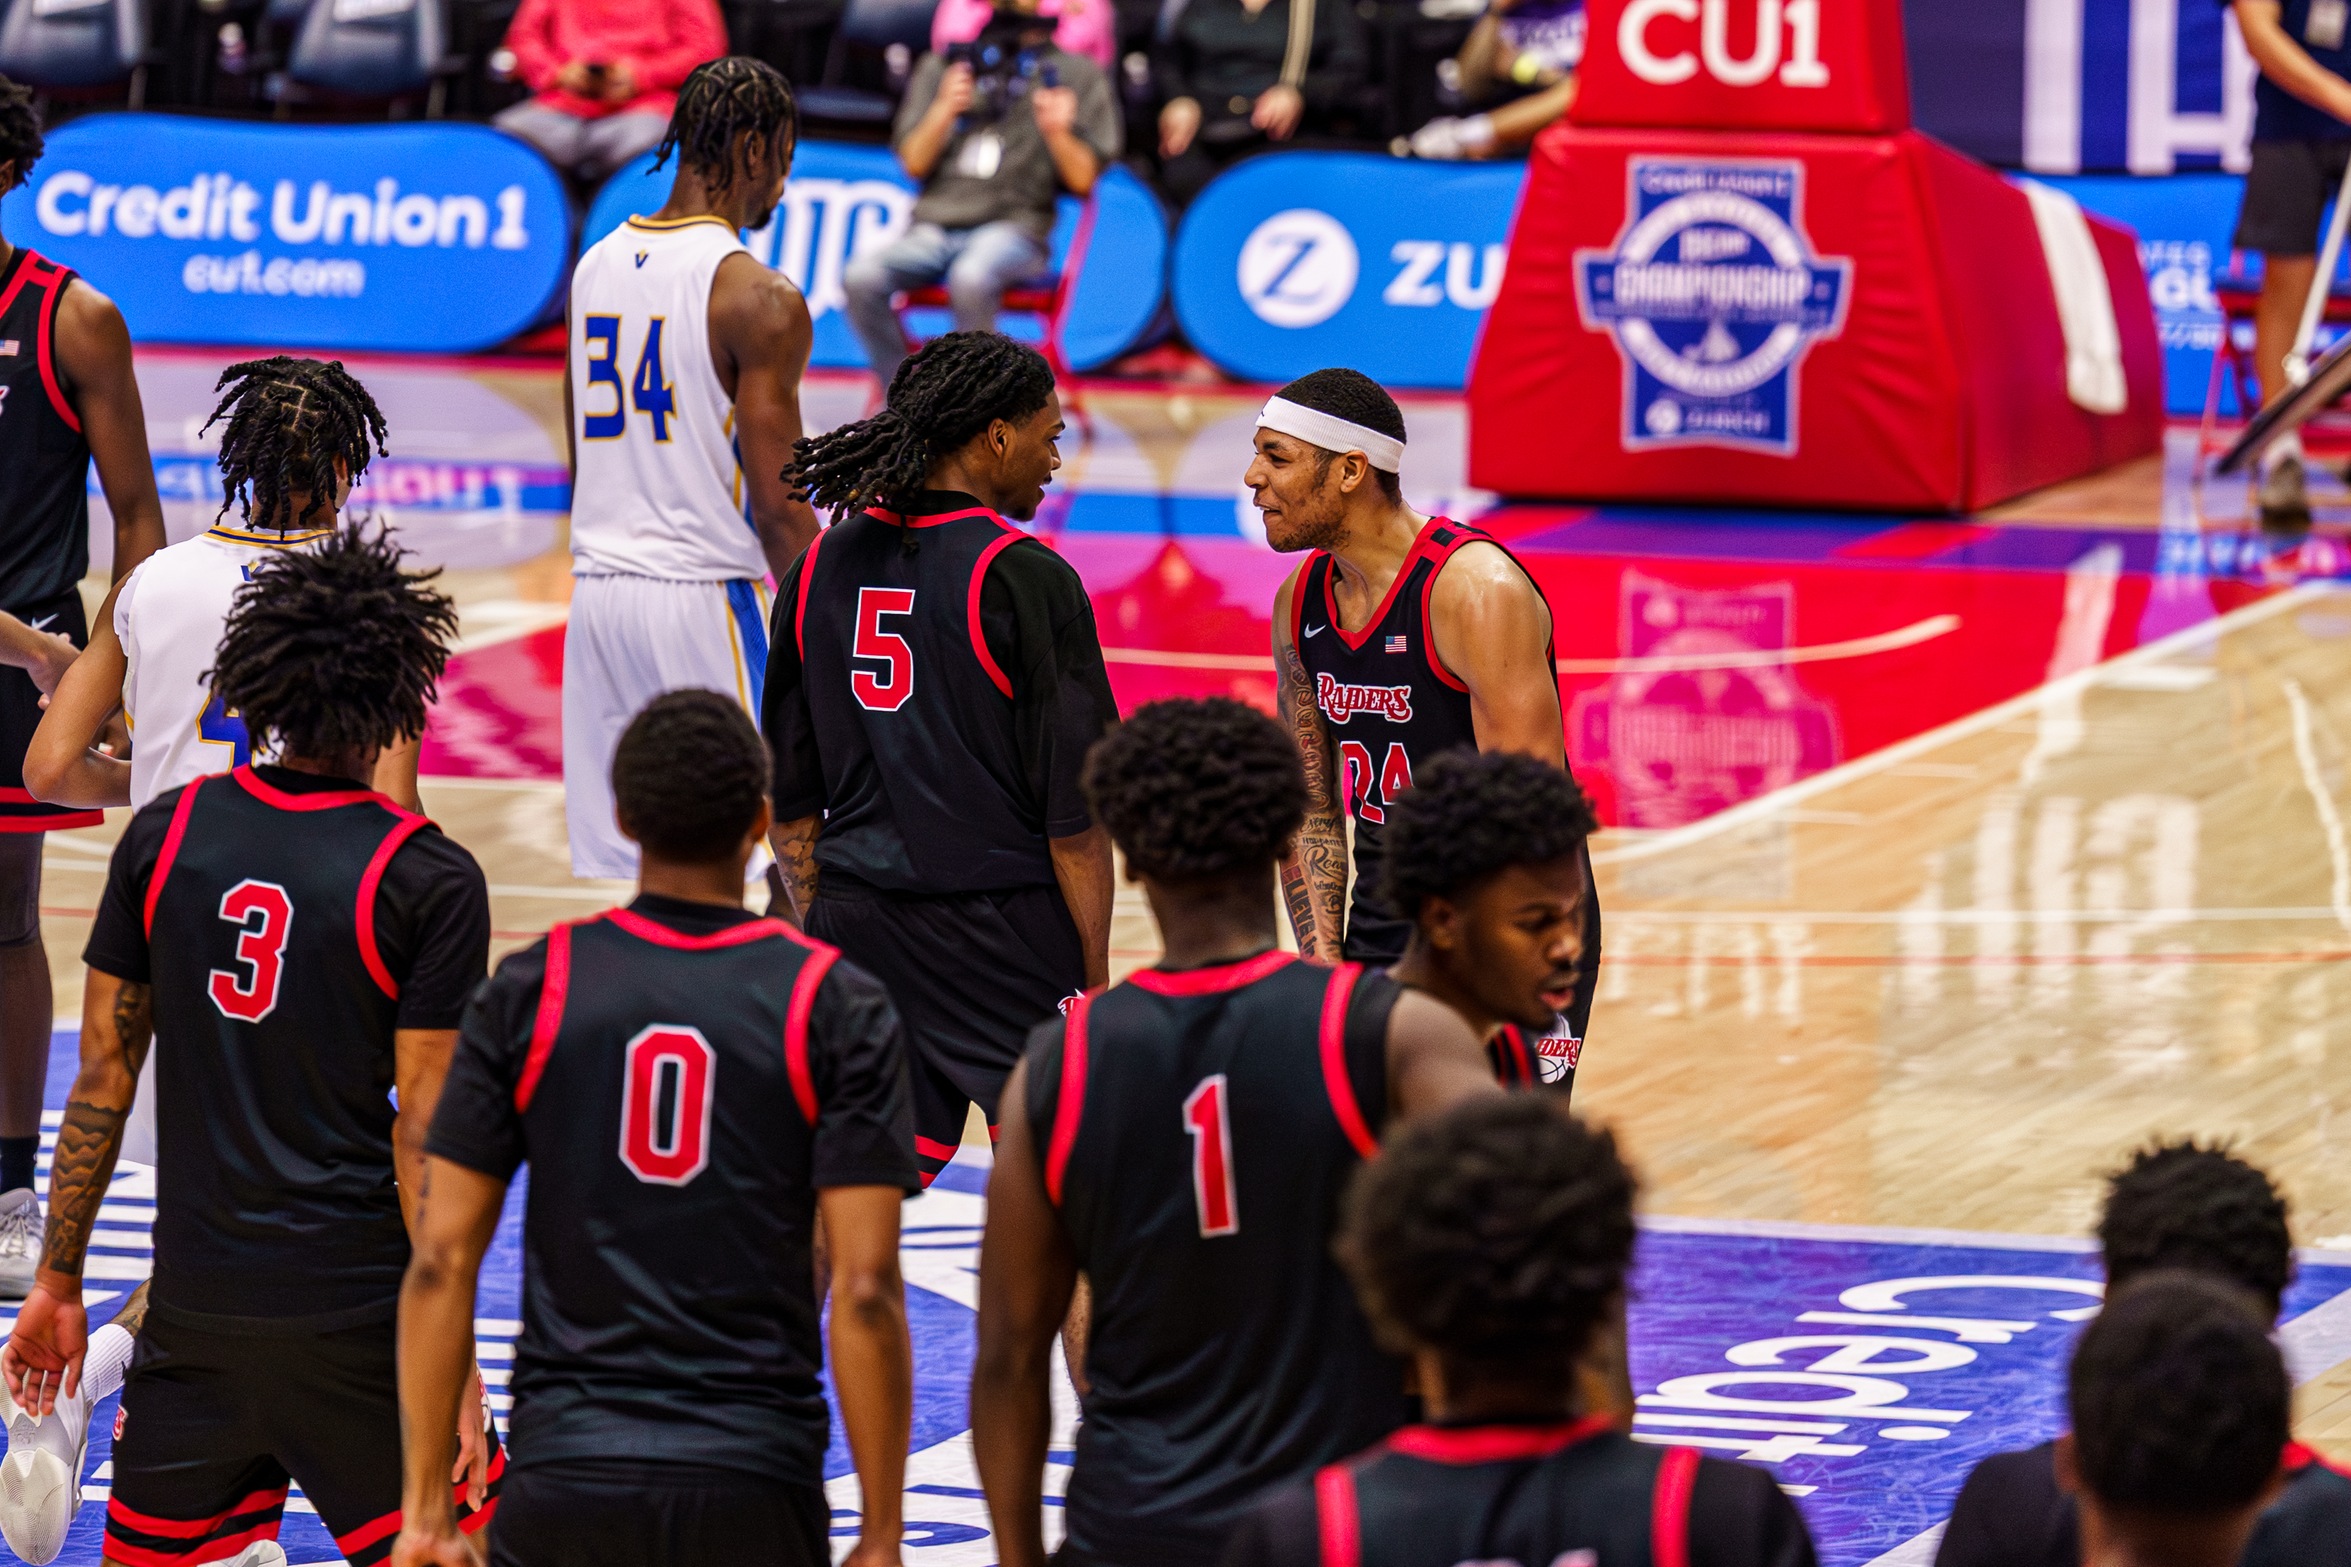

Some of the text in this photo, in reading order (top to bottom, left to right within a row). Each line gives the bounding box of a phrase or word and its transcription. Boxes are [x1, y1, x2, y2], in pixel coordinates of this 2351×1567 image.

[1617, 0, 1830, 88] CU1
[36, 168, 260, 243] Credit
[583, 312, 677, 444] 34
[851, 586, 916, 712] 5
[1317, 672, 1413, 725] RAIDERS
[1340, 740, 1414, 825] 24
[208, 878, 294, 1024] 3
[619, 1023, 717, 1187] 0
[1182, 1073, 1239, 1238] 1
[1629, 1275, 2107, 1463] Credit
